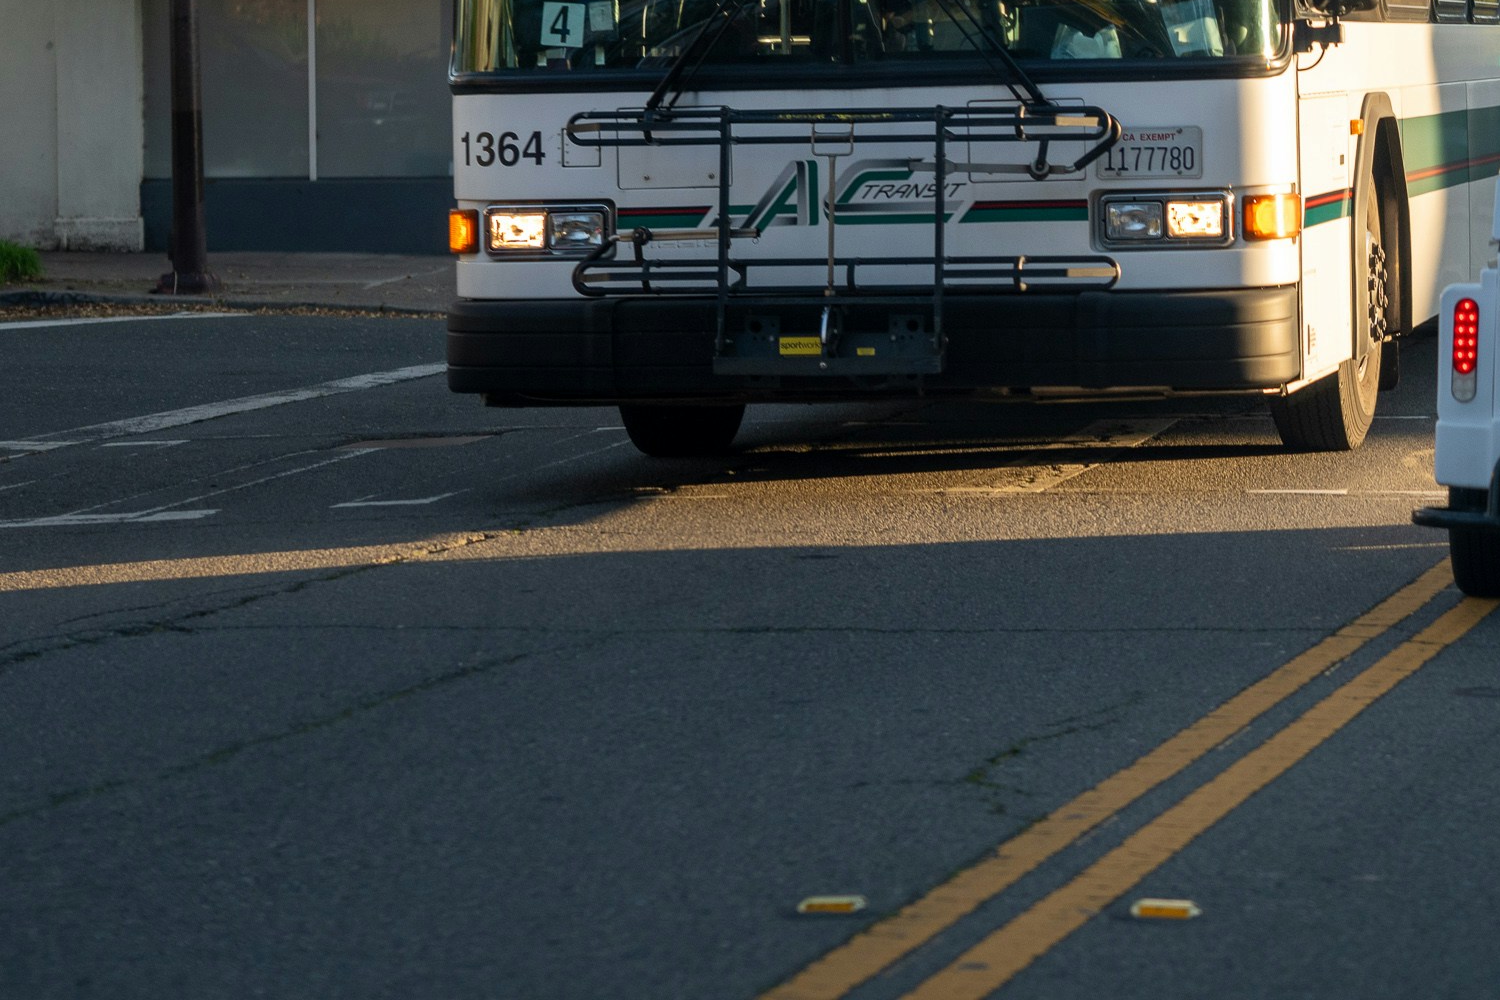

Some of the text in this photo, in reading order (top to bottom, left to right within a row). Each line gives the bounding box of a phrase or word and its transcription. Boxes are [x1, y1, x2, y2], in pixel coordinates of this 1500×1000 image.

[550, 5, 570, 43] 4
[461, 130, 546, 168] 1364
[1122, 133, 1176, 141] CA EXEMPT
[1104, 146, 1195, 171] 1177780
